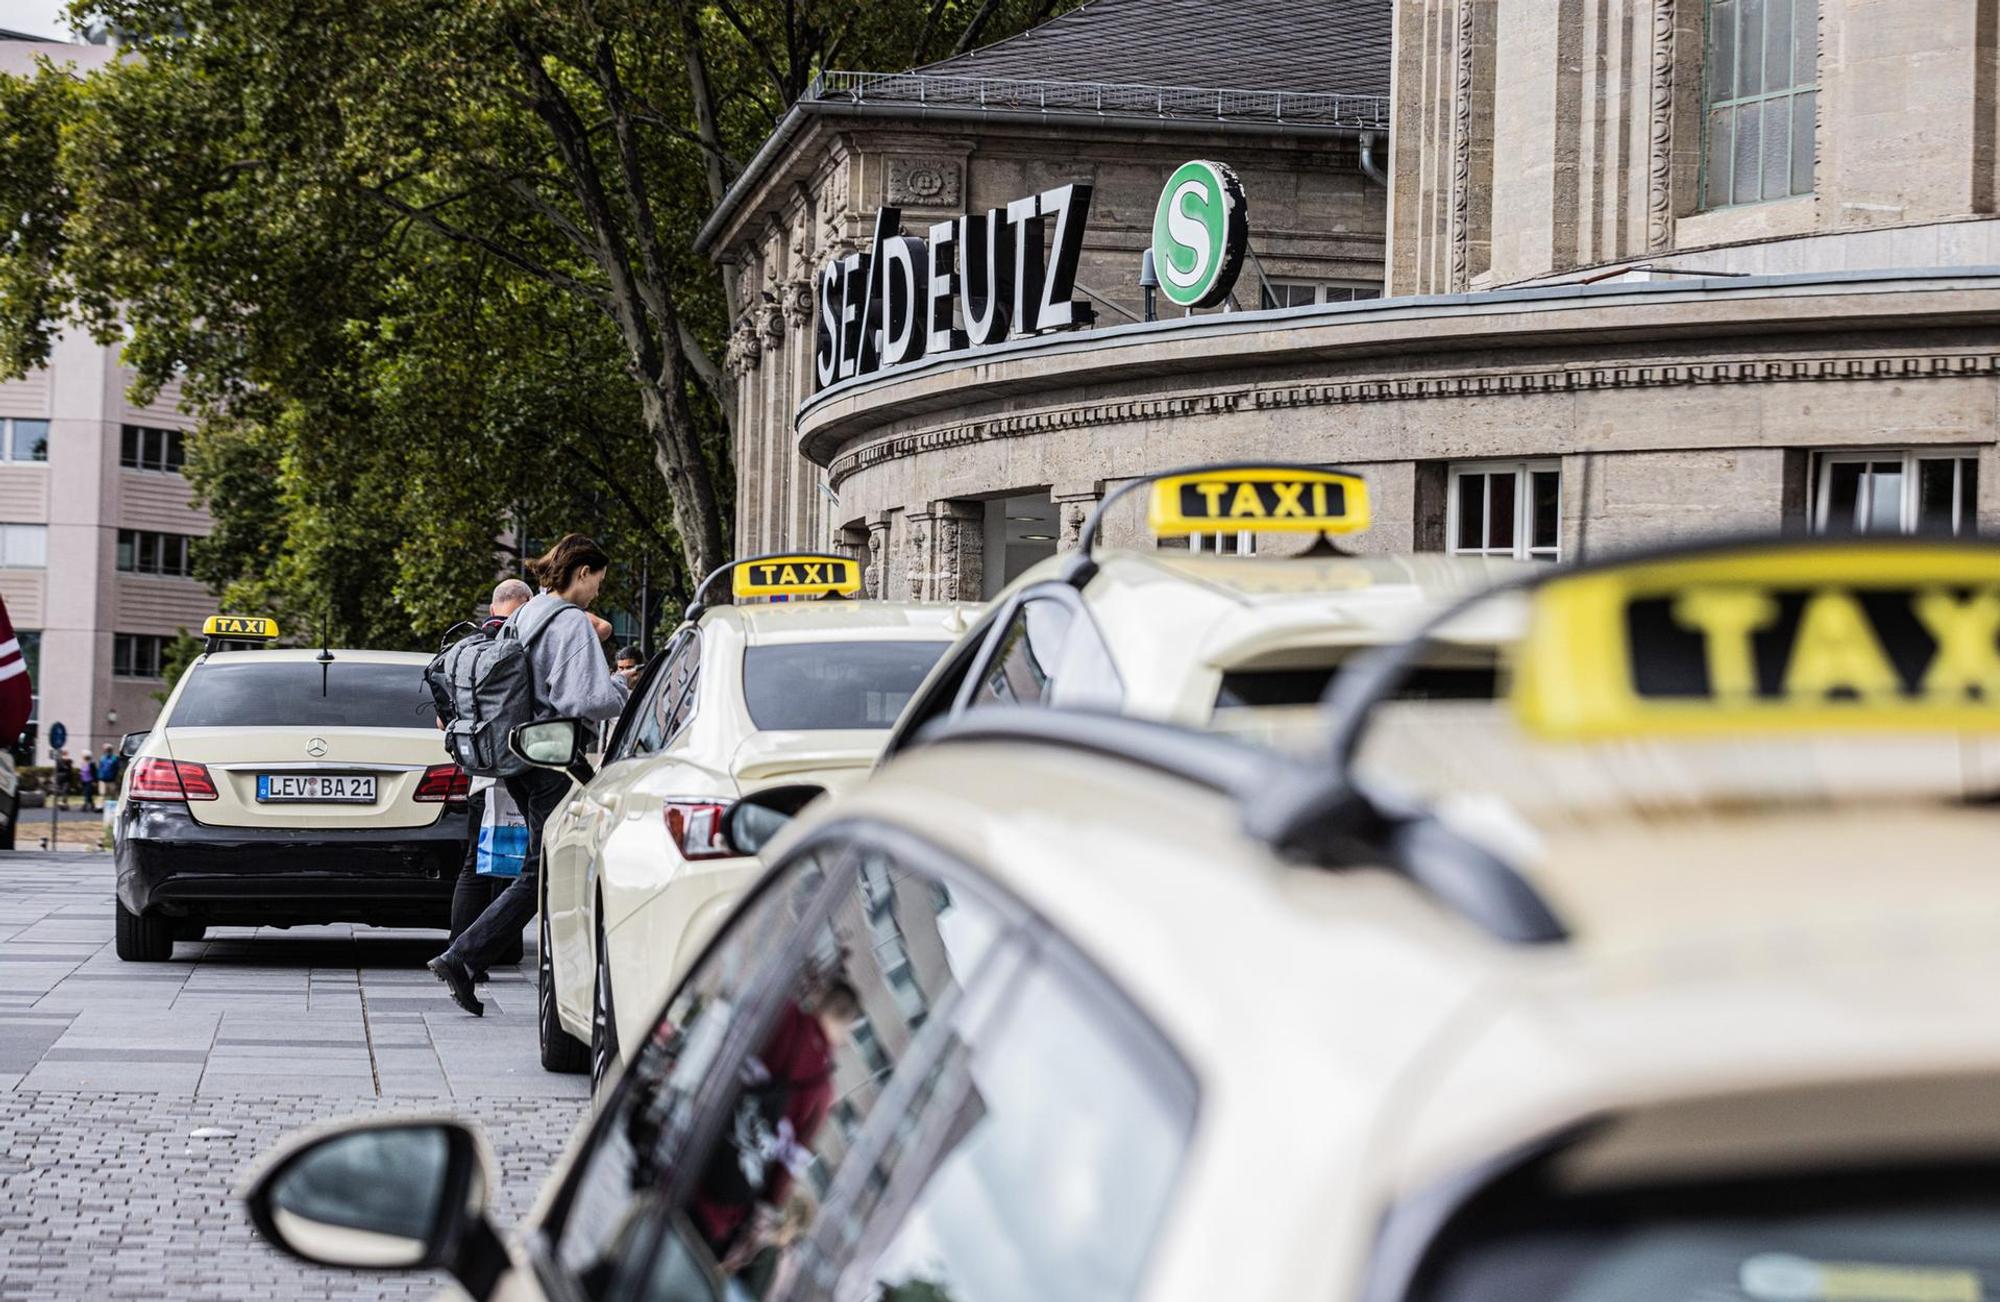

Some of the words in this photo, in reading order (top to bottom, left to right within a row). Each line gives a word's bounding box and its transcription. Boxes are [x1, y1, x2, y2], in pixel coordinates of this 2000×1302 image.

[1165, 180, 1210, 288] S
[1195, 481, 1332, 519] TAXI
[760, 563, 835, 585] TAXI
[217, 619, 264, 633] TAXI
[269, 778, 308, 796] LEV
[321, 778, 346, 796] BA
[350, 779, 374, 797] 21
